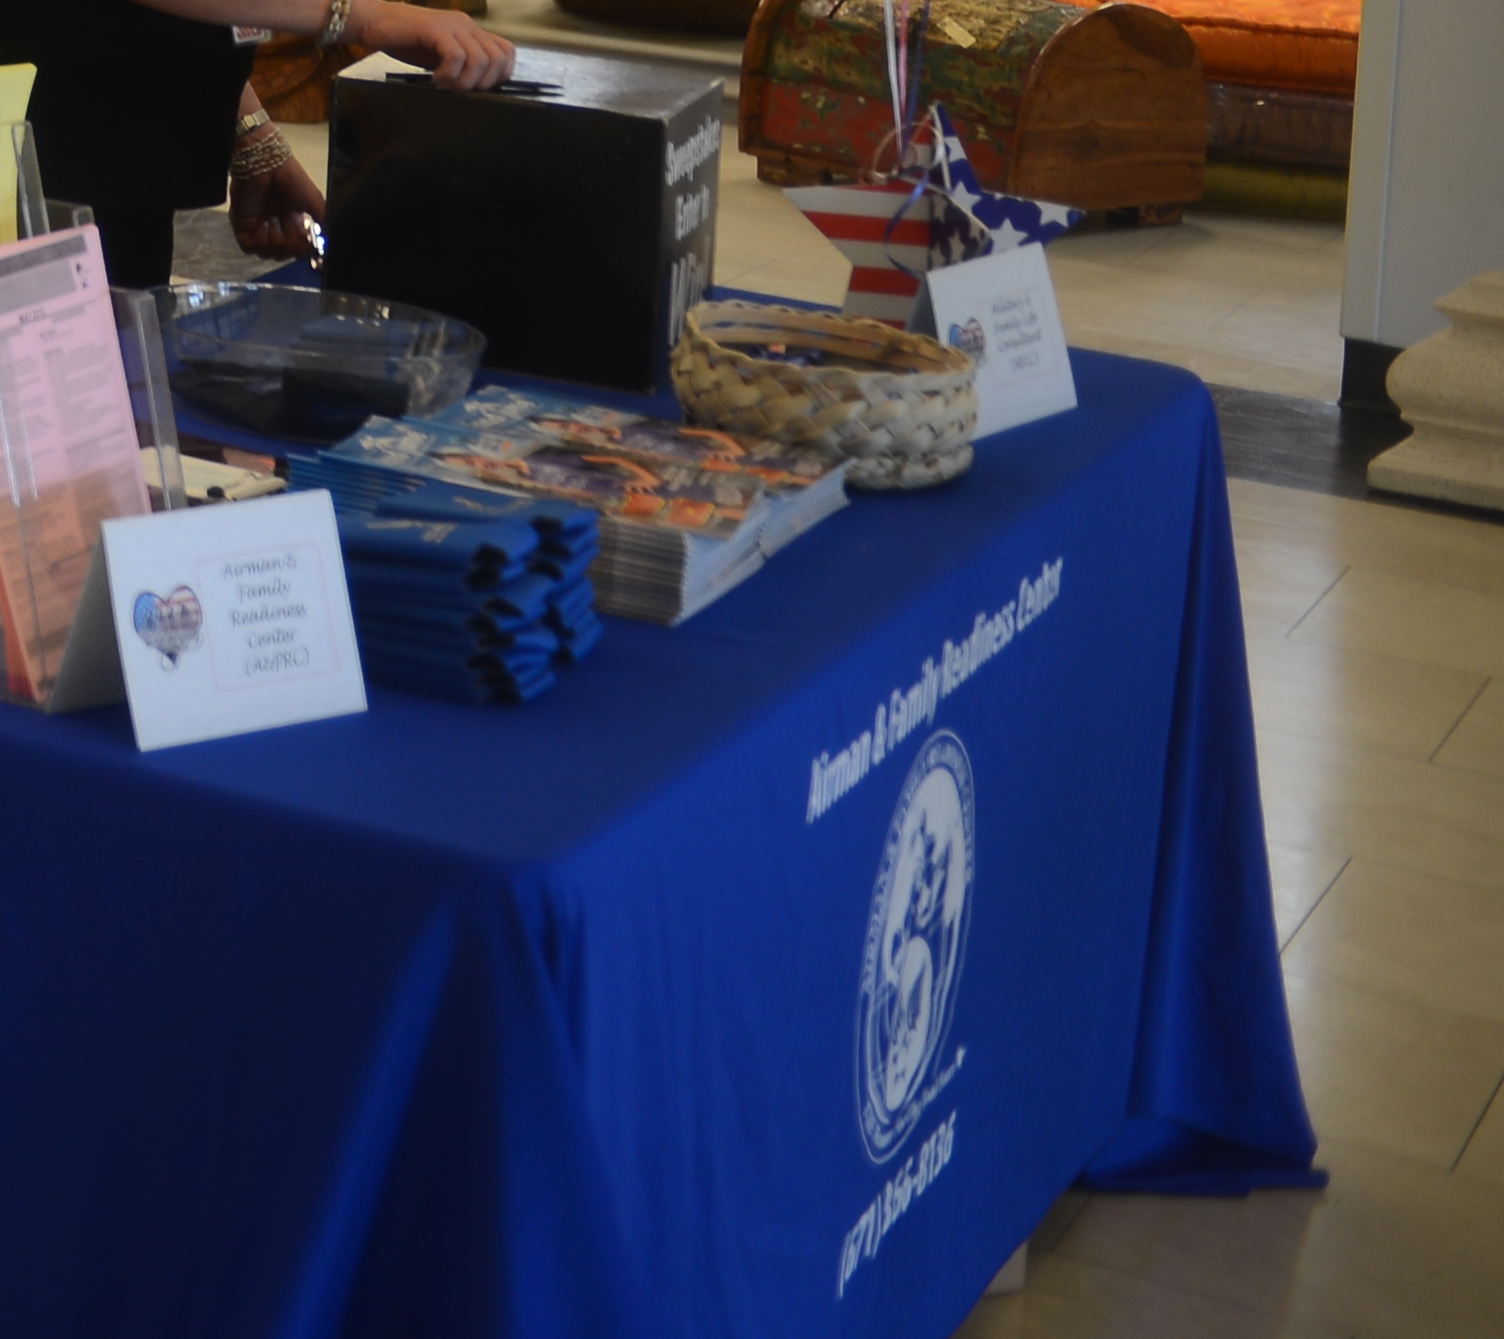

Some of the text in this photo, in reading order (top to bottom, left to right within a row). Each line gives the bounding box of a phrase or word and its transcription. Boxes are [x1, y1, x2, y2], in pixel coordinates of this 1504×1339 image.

[237, 578, 291, 605] Family
[230, 602, 308, 629] Readiness
[247, 628, 298, 651] Center
[805, 555, 1064, 825] Airman & Family Readiness Center
